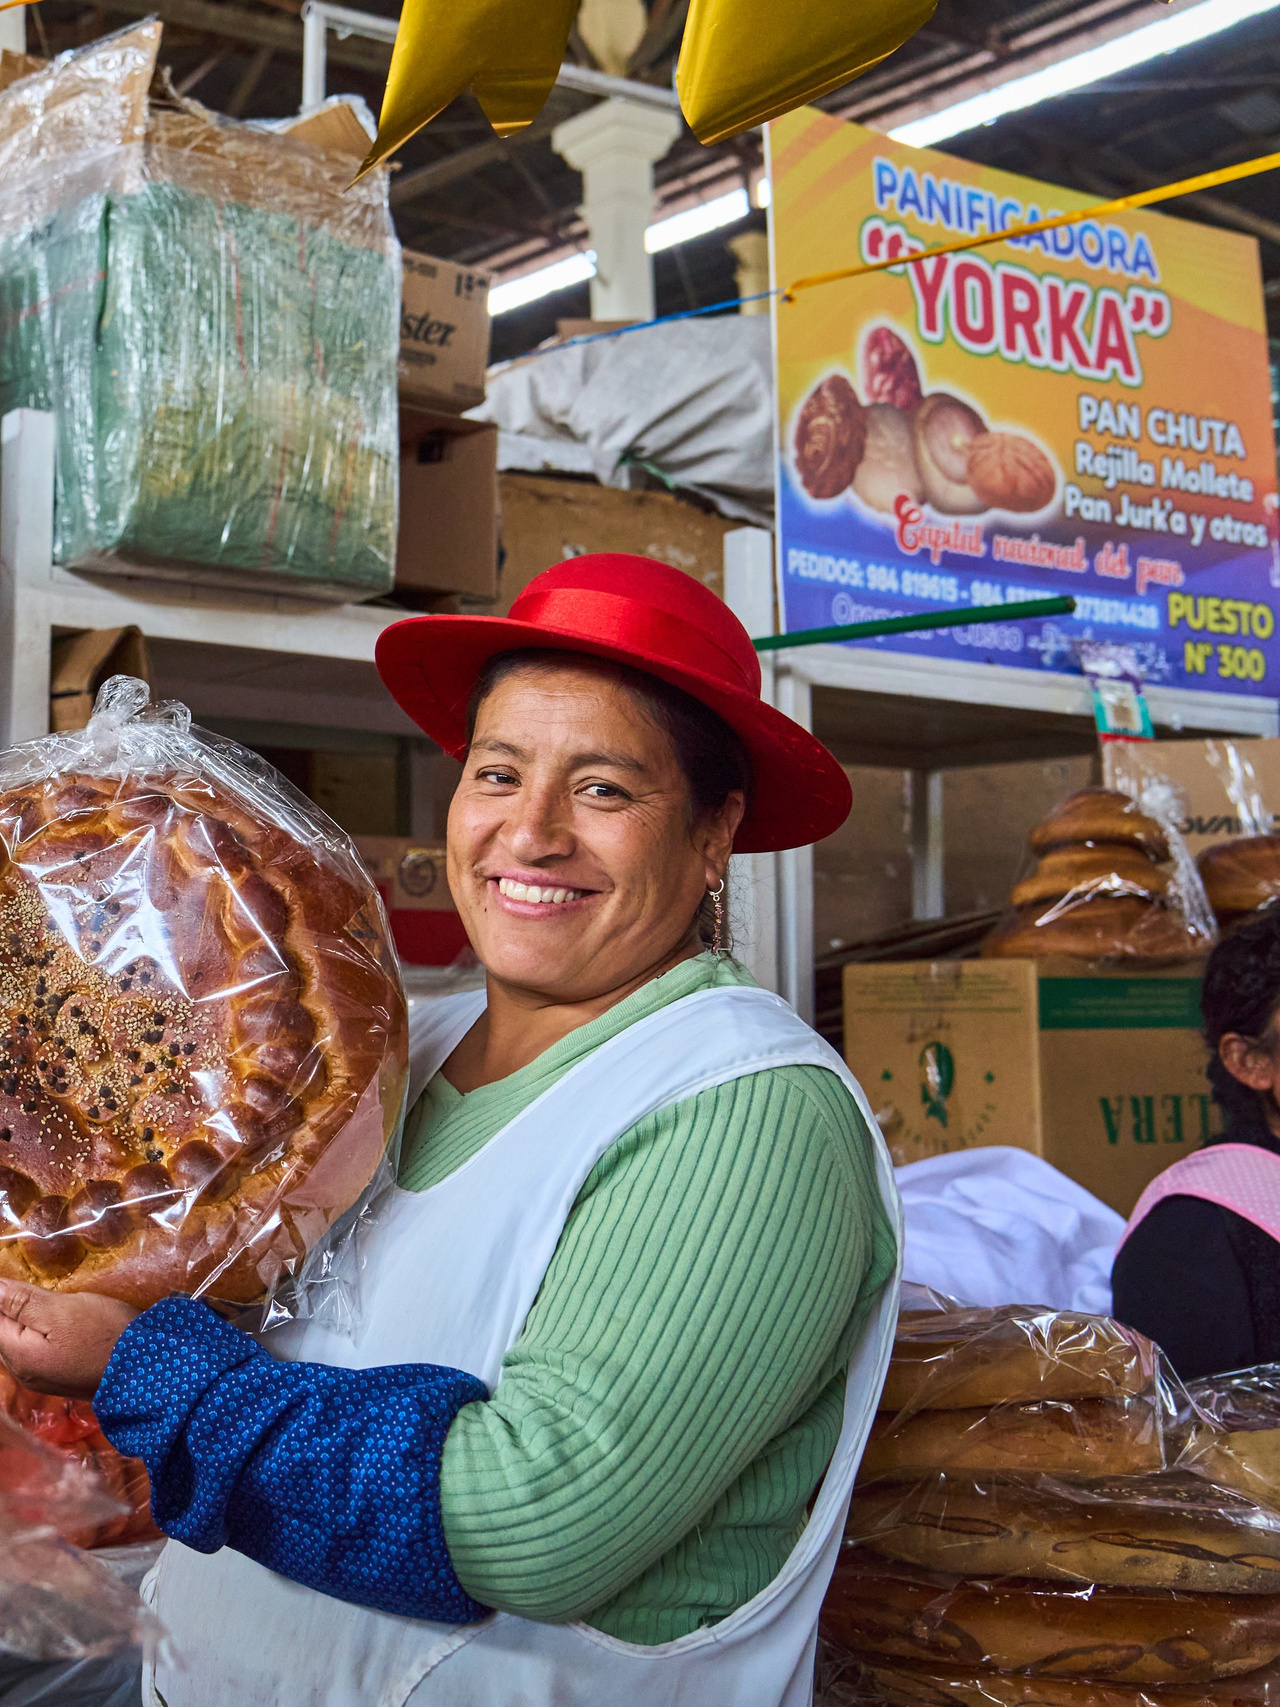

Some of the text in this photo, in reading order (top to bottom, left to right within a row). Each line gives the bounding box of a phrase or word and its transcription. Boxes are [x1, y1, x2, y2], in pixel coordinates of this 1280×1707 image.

[875, 161, 1159, 281] PANIFICADORA
[1079, 394, 1247, 459] PAN CHUTA
[1075, 441, 1254, 502] Rejilla Mollete
[894, 492, 1186, 595] Capital nacional del pan
[1065, 483, 1269, 548] Pan Jurk'a y otros
[787, 547, 865, 588] PEDIDOS:
[866, 563, 900, 594] 984
[1167, 591, 1276, 640] PUESTO
[1216, 643, 1266, 683] 300
